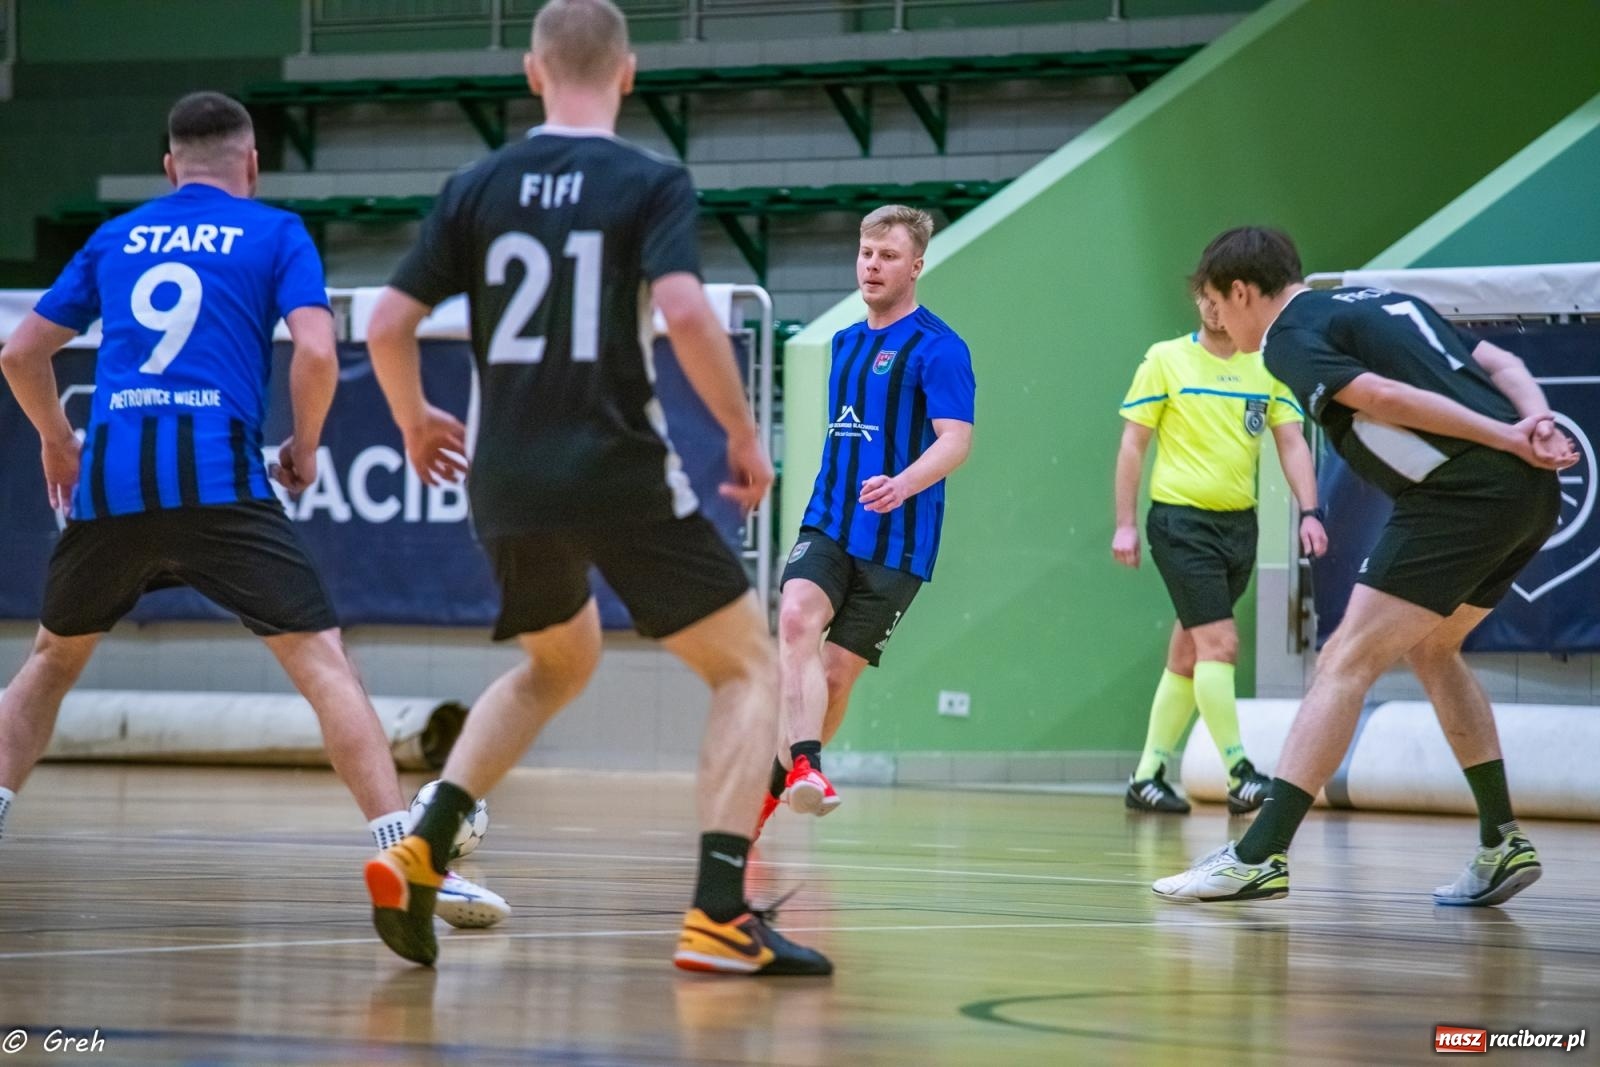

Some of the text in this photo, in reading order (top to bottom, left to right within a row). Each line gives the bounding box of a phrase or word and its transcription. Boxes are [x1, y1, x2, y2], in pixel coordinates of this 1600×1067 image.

[519, 170, 584, 209] FIFI
[122, 223, 244, 255] START
[484, 230, 604, 365] 21
[130, 261, 203, 375] 9
[109, 387, 222, 411] PIETROWICE WIELKIE
